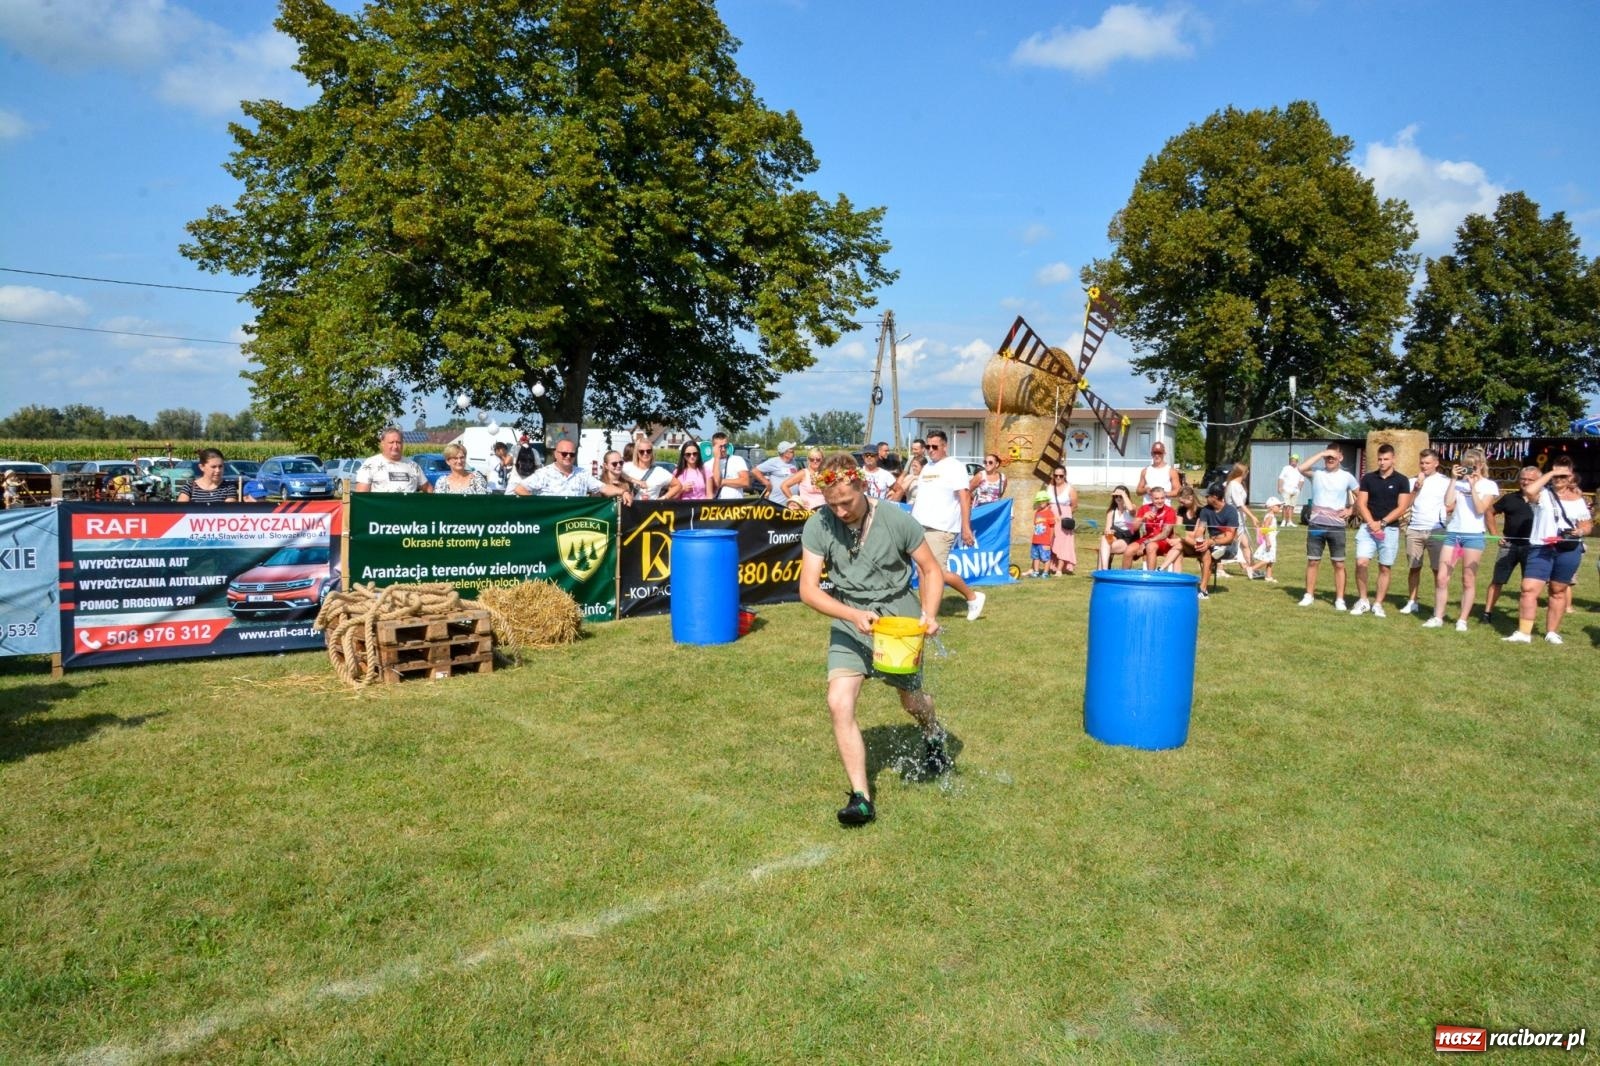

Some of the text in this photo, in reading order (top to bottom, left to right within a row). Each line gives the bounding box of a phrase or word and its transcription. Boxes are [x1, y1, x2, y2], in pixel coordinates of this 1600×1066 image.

[699, 505, 773, 521] DEKARSTWO
[86, 517, 147, 535] RAFI
[189, 515, 326, 532] WYPOŻYCZALNIA
[368, 521, 541, 538] Drzewka i krzewy ozdobne
[402, 537, 511, 550] Okrasné stromy a keře
[78, 556, 190, 570] WYPOŻYCZALNIA AUT
[361, 561, 547, 580] Aranżacja terenów zielonych
[79, 574, 228, 591] WYPOŻYCZALNIA AUTOLAWET
[79, 595, 196, 611] POMOC DROGOWA 24H
[8, 624, 38, 637] 532
[106, 624, 211, 646] 508 976 312
